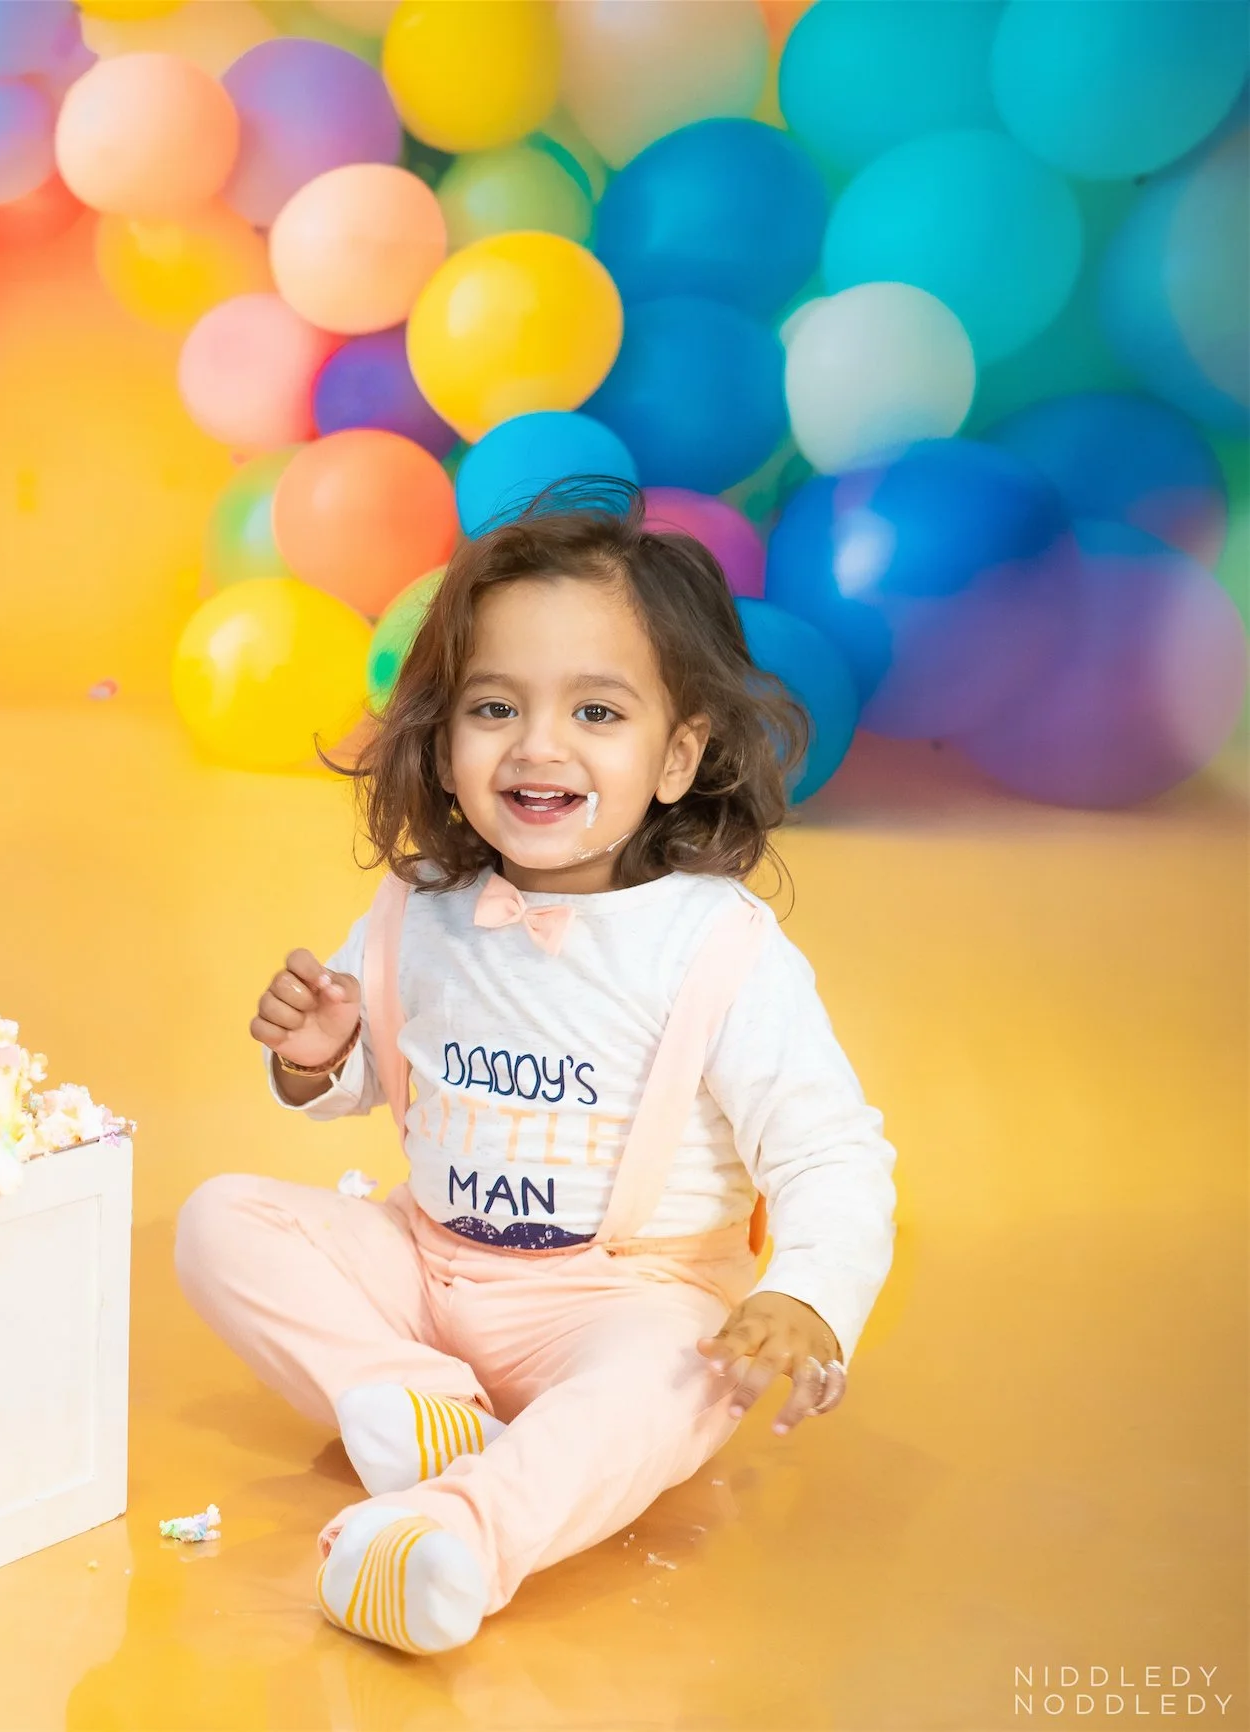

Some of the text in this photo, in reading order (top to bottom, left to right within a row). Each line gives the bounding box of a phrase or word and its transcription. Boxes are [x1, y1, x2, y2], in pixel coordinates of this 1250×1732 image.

[442, 1041, 598, 1105] DADDY'S
[418, 1093, 629, 1167] LITTLE
[449, 1165, 555, 1216] MAN
